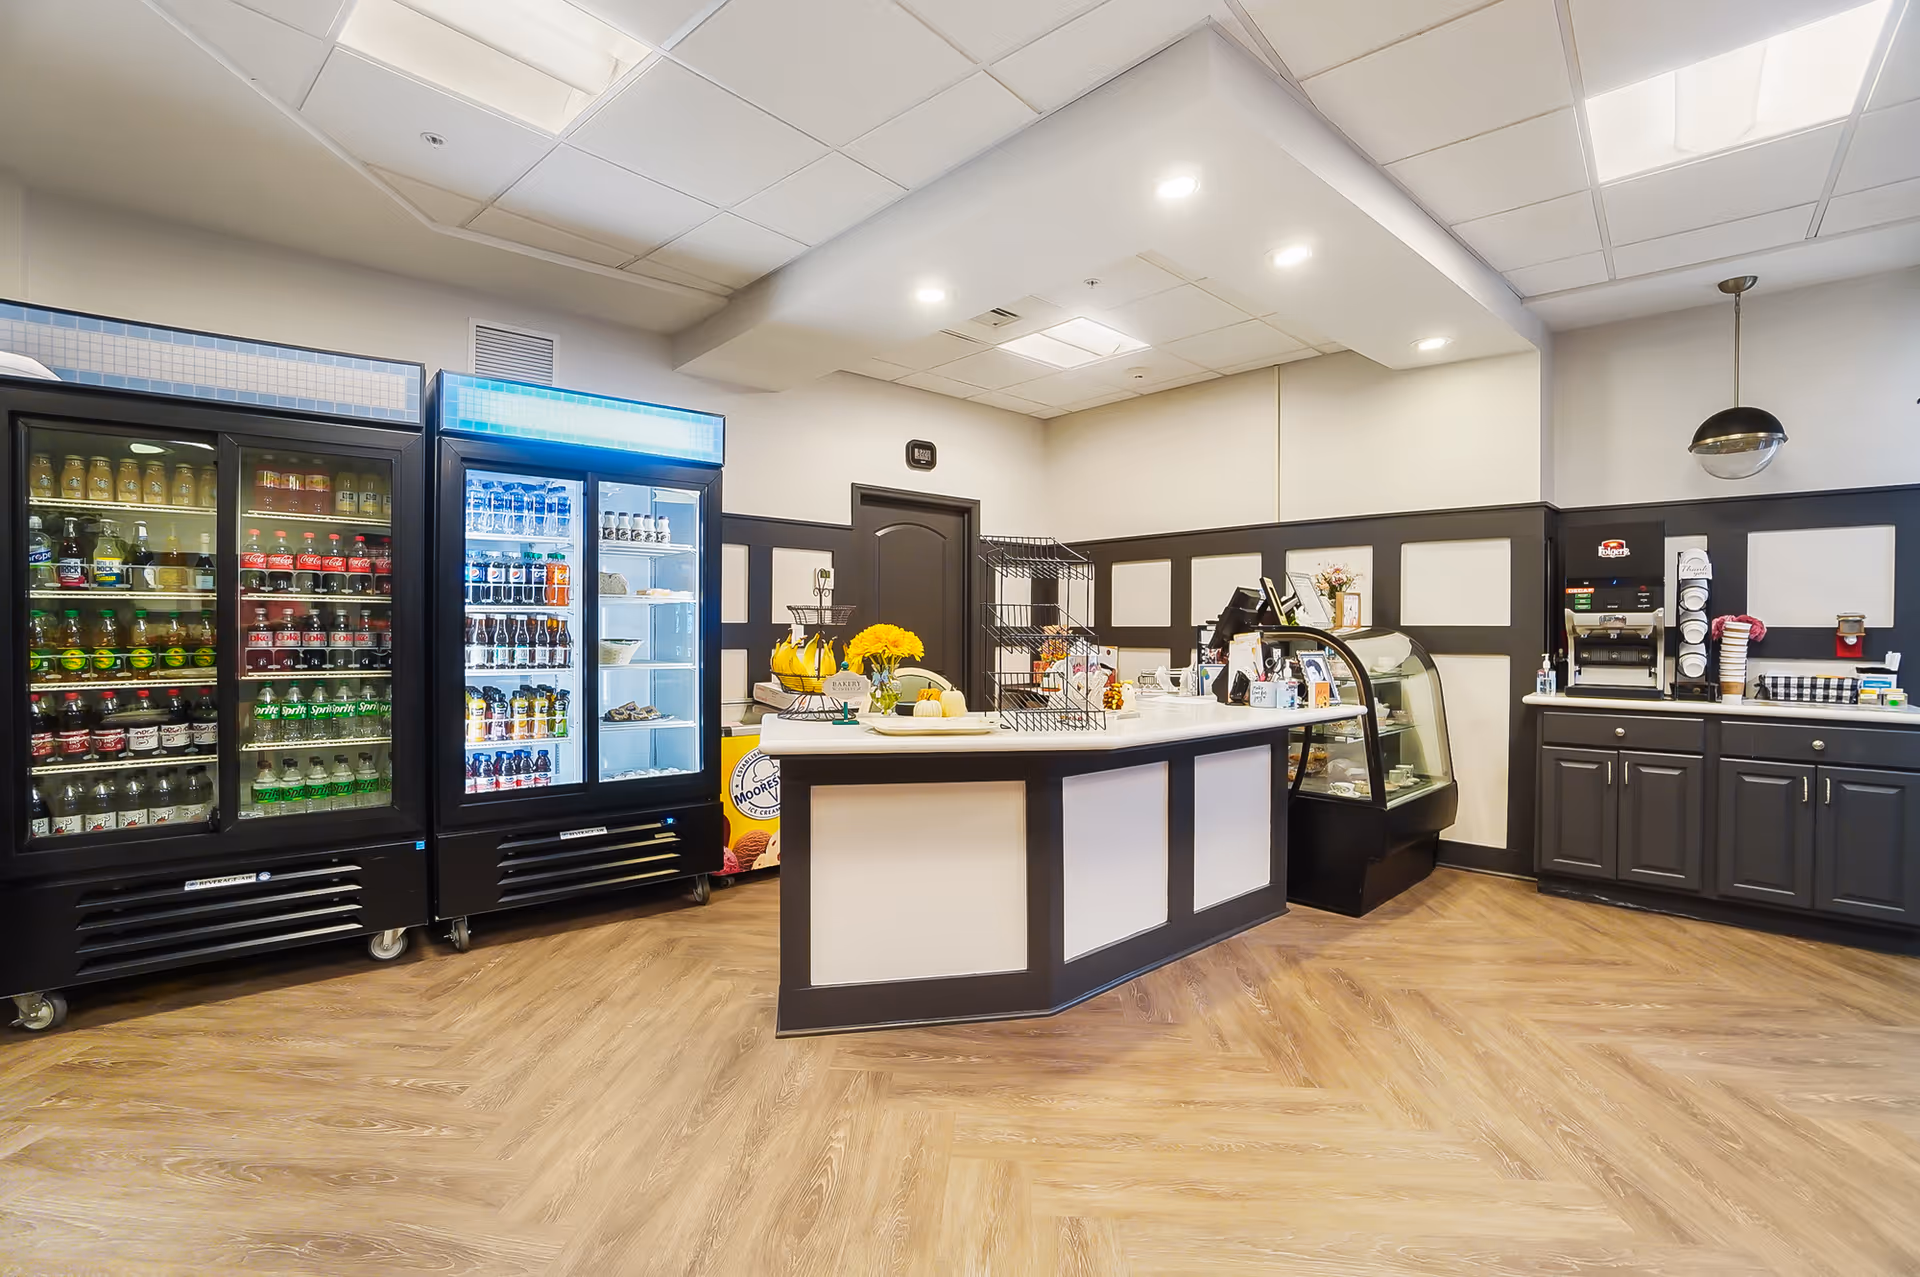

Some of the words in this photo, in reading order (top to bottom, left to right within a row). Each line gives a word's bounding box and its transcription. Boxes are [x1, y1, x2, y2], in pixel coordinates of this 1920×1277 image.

[300, 554, 321, 565] Coca-Co
[249, 633, 269, 642] oke
[275, 632, 301, 642] Coke
[282, 705, 307, 715] Sprite
[311, 704, 331, 715] Spri
[360, 702, 378, 711] Spri
[734, 776, 780, 806] MOORES
